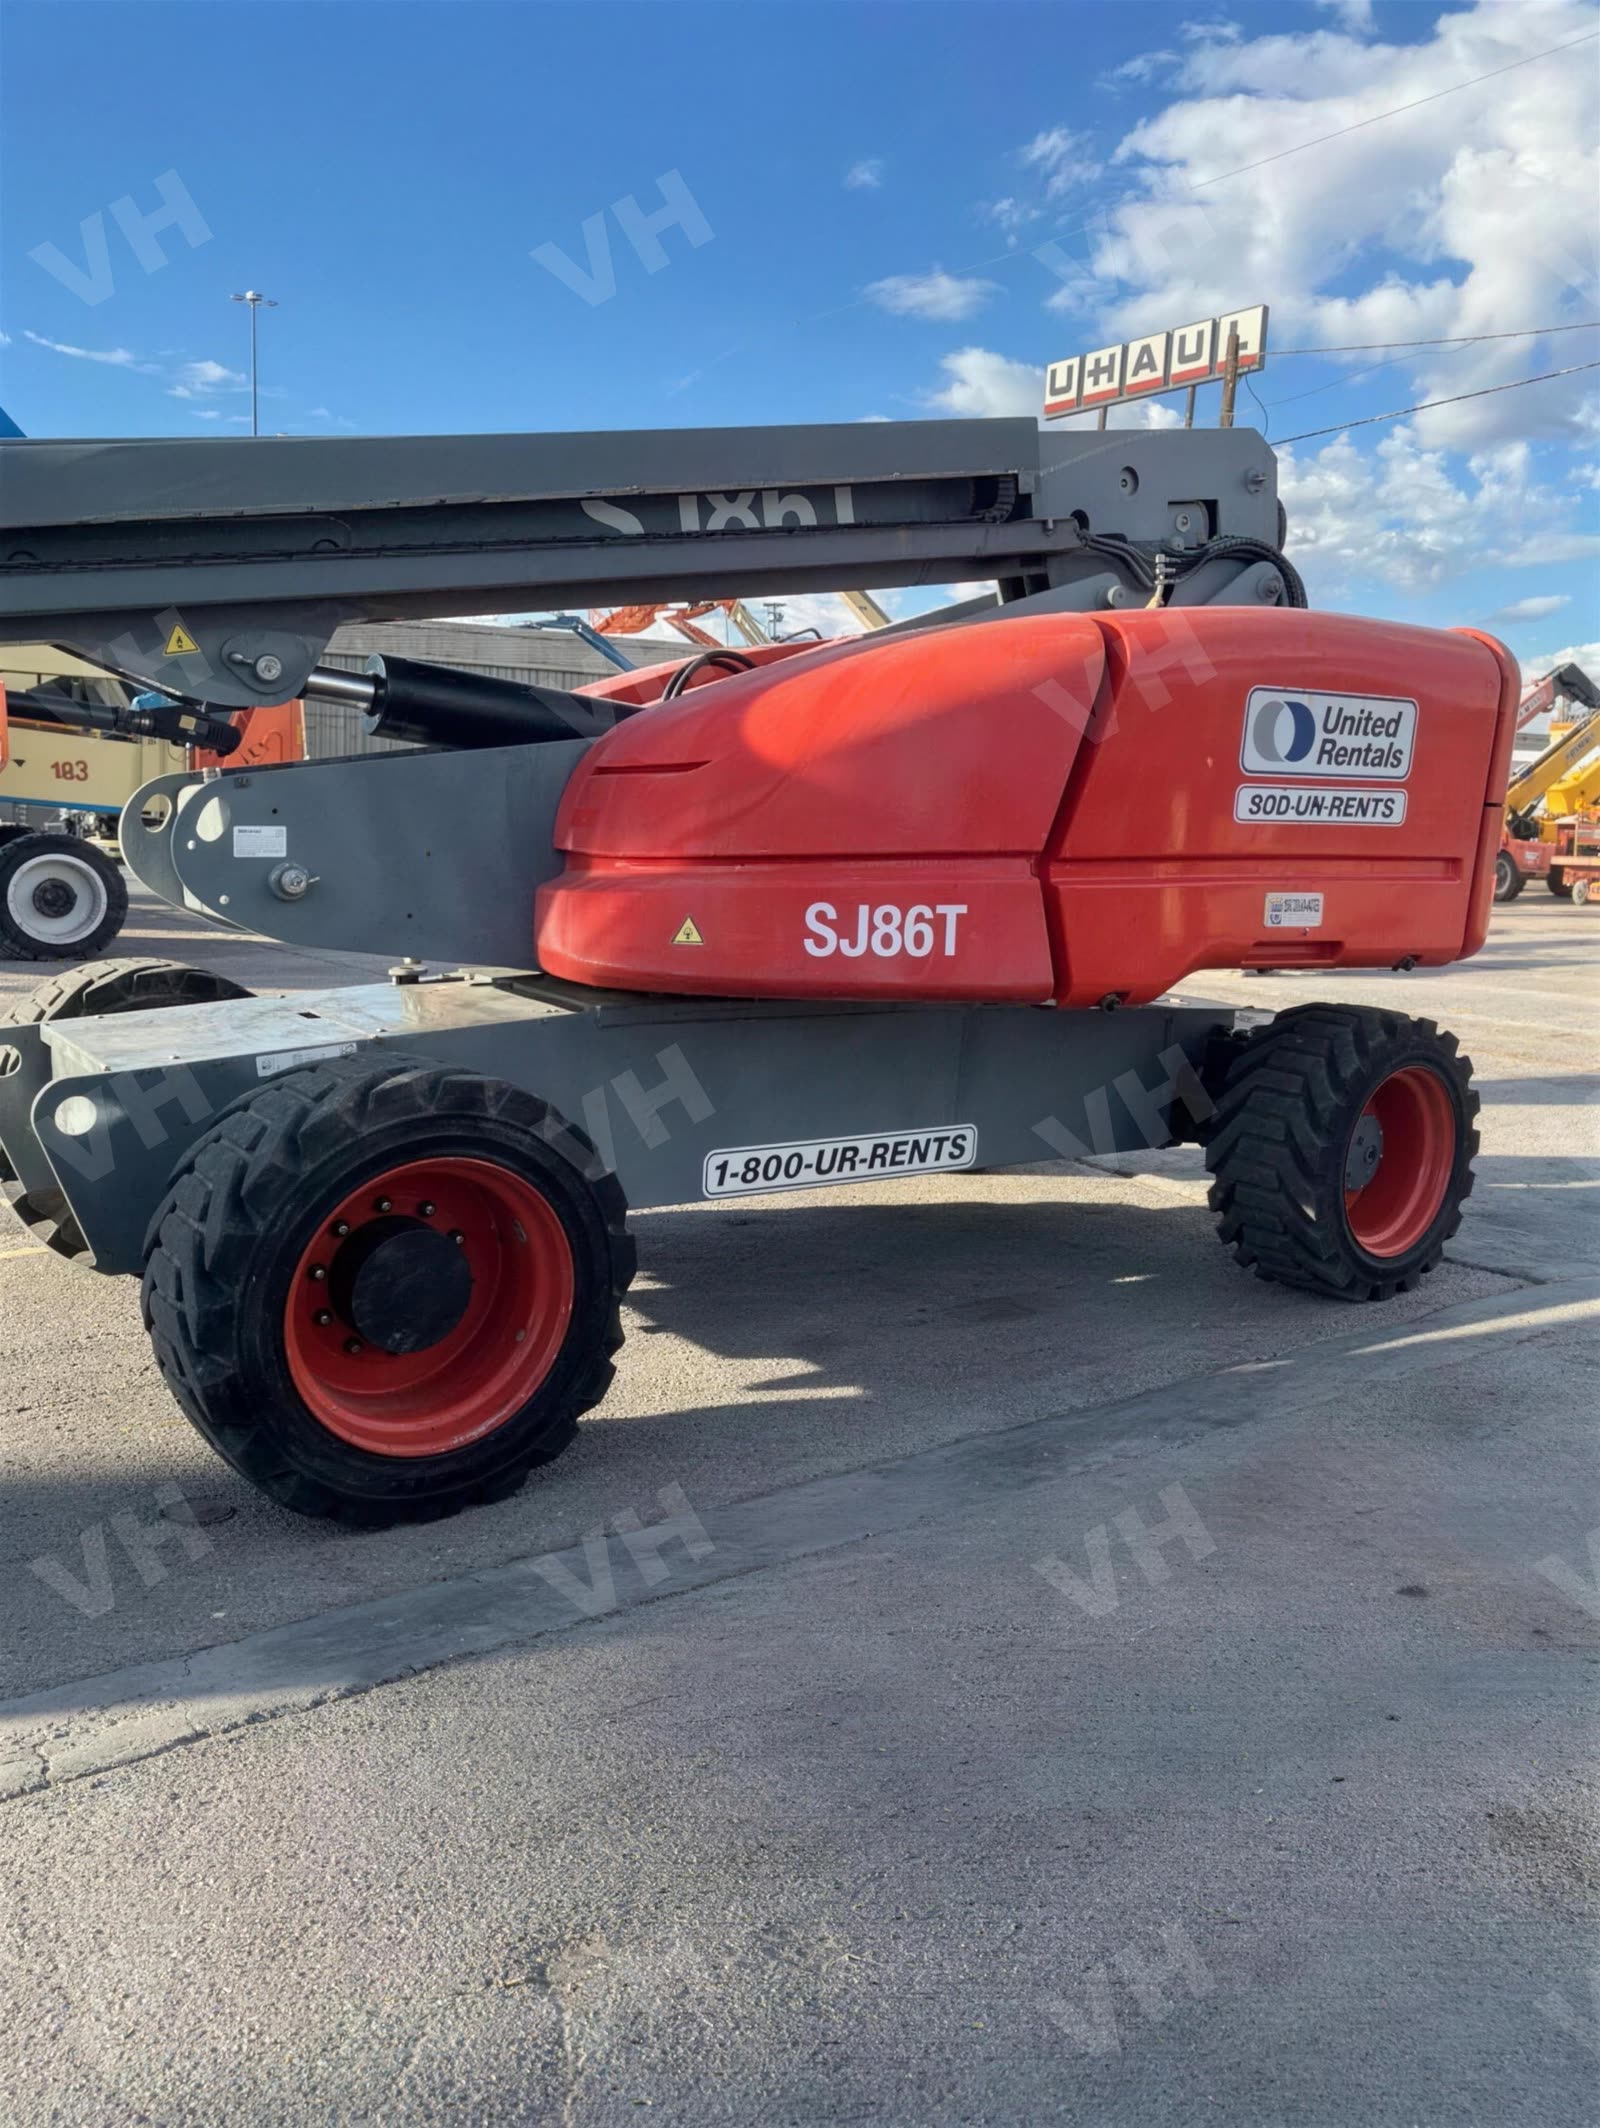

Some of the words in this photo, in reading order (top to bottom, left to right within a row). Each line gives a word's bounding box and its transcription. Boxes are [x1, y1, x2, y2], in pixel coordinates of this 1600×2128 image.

[1322, 706, 1403, 738] United
[1316, 738, 1403, 769] Rentals
[50, 760, 89, 782] 183
[803, 902, 968, 957] SJ86T
[714, 1134, 967, 1187] 1-800-UR-RENTS
